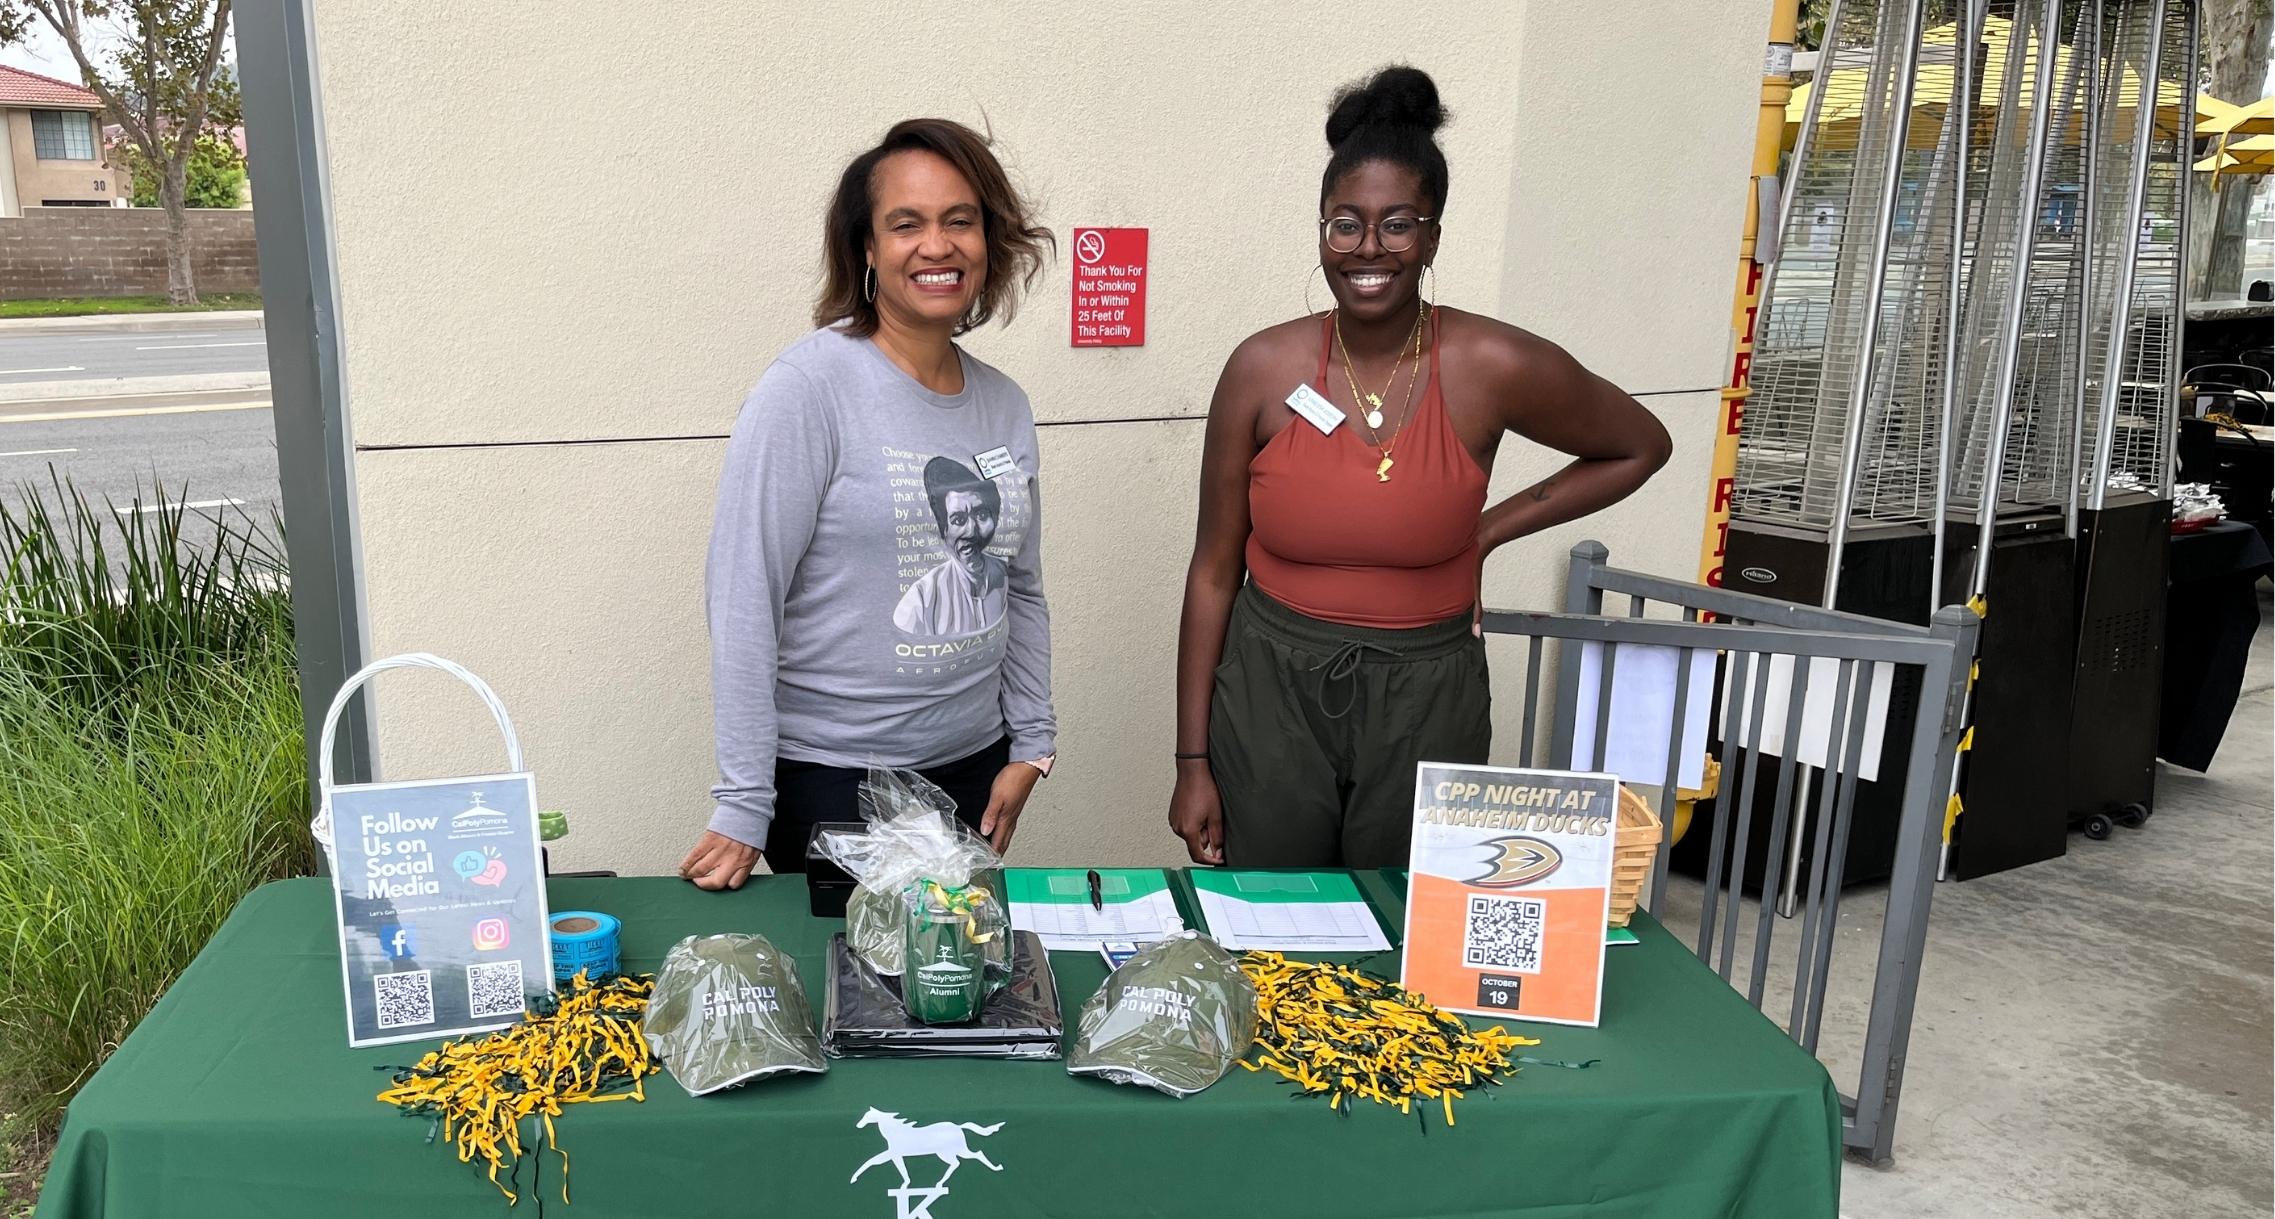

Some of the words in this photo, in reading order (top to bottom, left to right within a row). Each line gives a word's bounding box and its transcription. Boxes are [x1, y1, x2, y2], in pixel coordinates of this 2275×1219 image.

[93, 180, 106, 191] 30
[1080, 265, 1107, 277] Thank
[1109, 265, 1125, 277] You
[1128, 265, 1142, 277] For
[1079, 280, 1095, 292] Not
[1097, 280, 1136, 294] Smoking
[1078, 296, 1087, 306] In
[1089, 297, 1099, 306] or
[1101, 295, 1129, 306] Within
[1078, 311, 1090, 322] 25
[1092, 310, 1112, 321] Feet
[1114, 309, 1125, 321] Of
[1078, 325, 1096, 337] This
[1099, 325, 1131, 338] Facility
[882, 446, 914, 460] Choose
[887, 463, 905, 473] and
[893, 490, 914, 503] that
[895, 506, 909, 521] by
[916, 508, 923, 518] a
[1009, 502, 1020, 515] by
[896, 537, 909, 549] To
[912, 536, 925, 548] be
[897, 553, 921, 567] your
[895, 635, 983, 657] OCTAVIA
[1434, 781, 1481, 802] CPP
[1484, 784, 1561, 807] NIGHT
[1561, 790, 1597, 810] AT
[361, 811, 439, 836] Follow
[1421, 805, 1530, 832] ANAHEIM
[1533, 812, 1609, 837] DUCKS
[363, 838, 391, 858] Us
[396, 838, 427, 855] on
[366, 851, 434, 879] Social
[368, 875, 440, 899] Media
[1481, 977, 1518, 989] OCTOBER
[702, 990, 737, 1005] CAL
[739, 986, 776, 1000] POLY
[929, 987, 960, 996] Alumni
[1122, 986, 1148, 998] CAL
[1153, 989, 1197, 1007] POLY
[1488, 990, 1508, 1005] 19
[702, 1000, 780, 1020] POMONA
[1119, 999, 1192, 1022] POMONA
